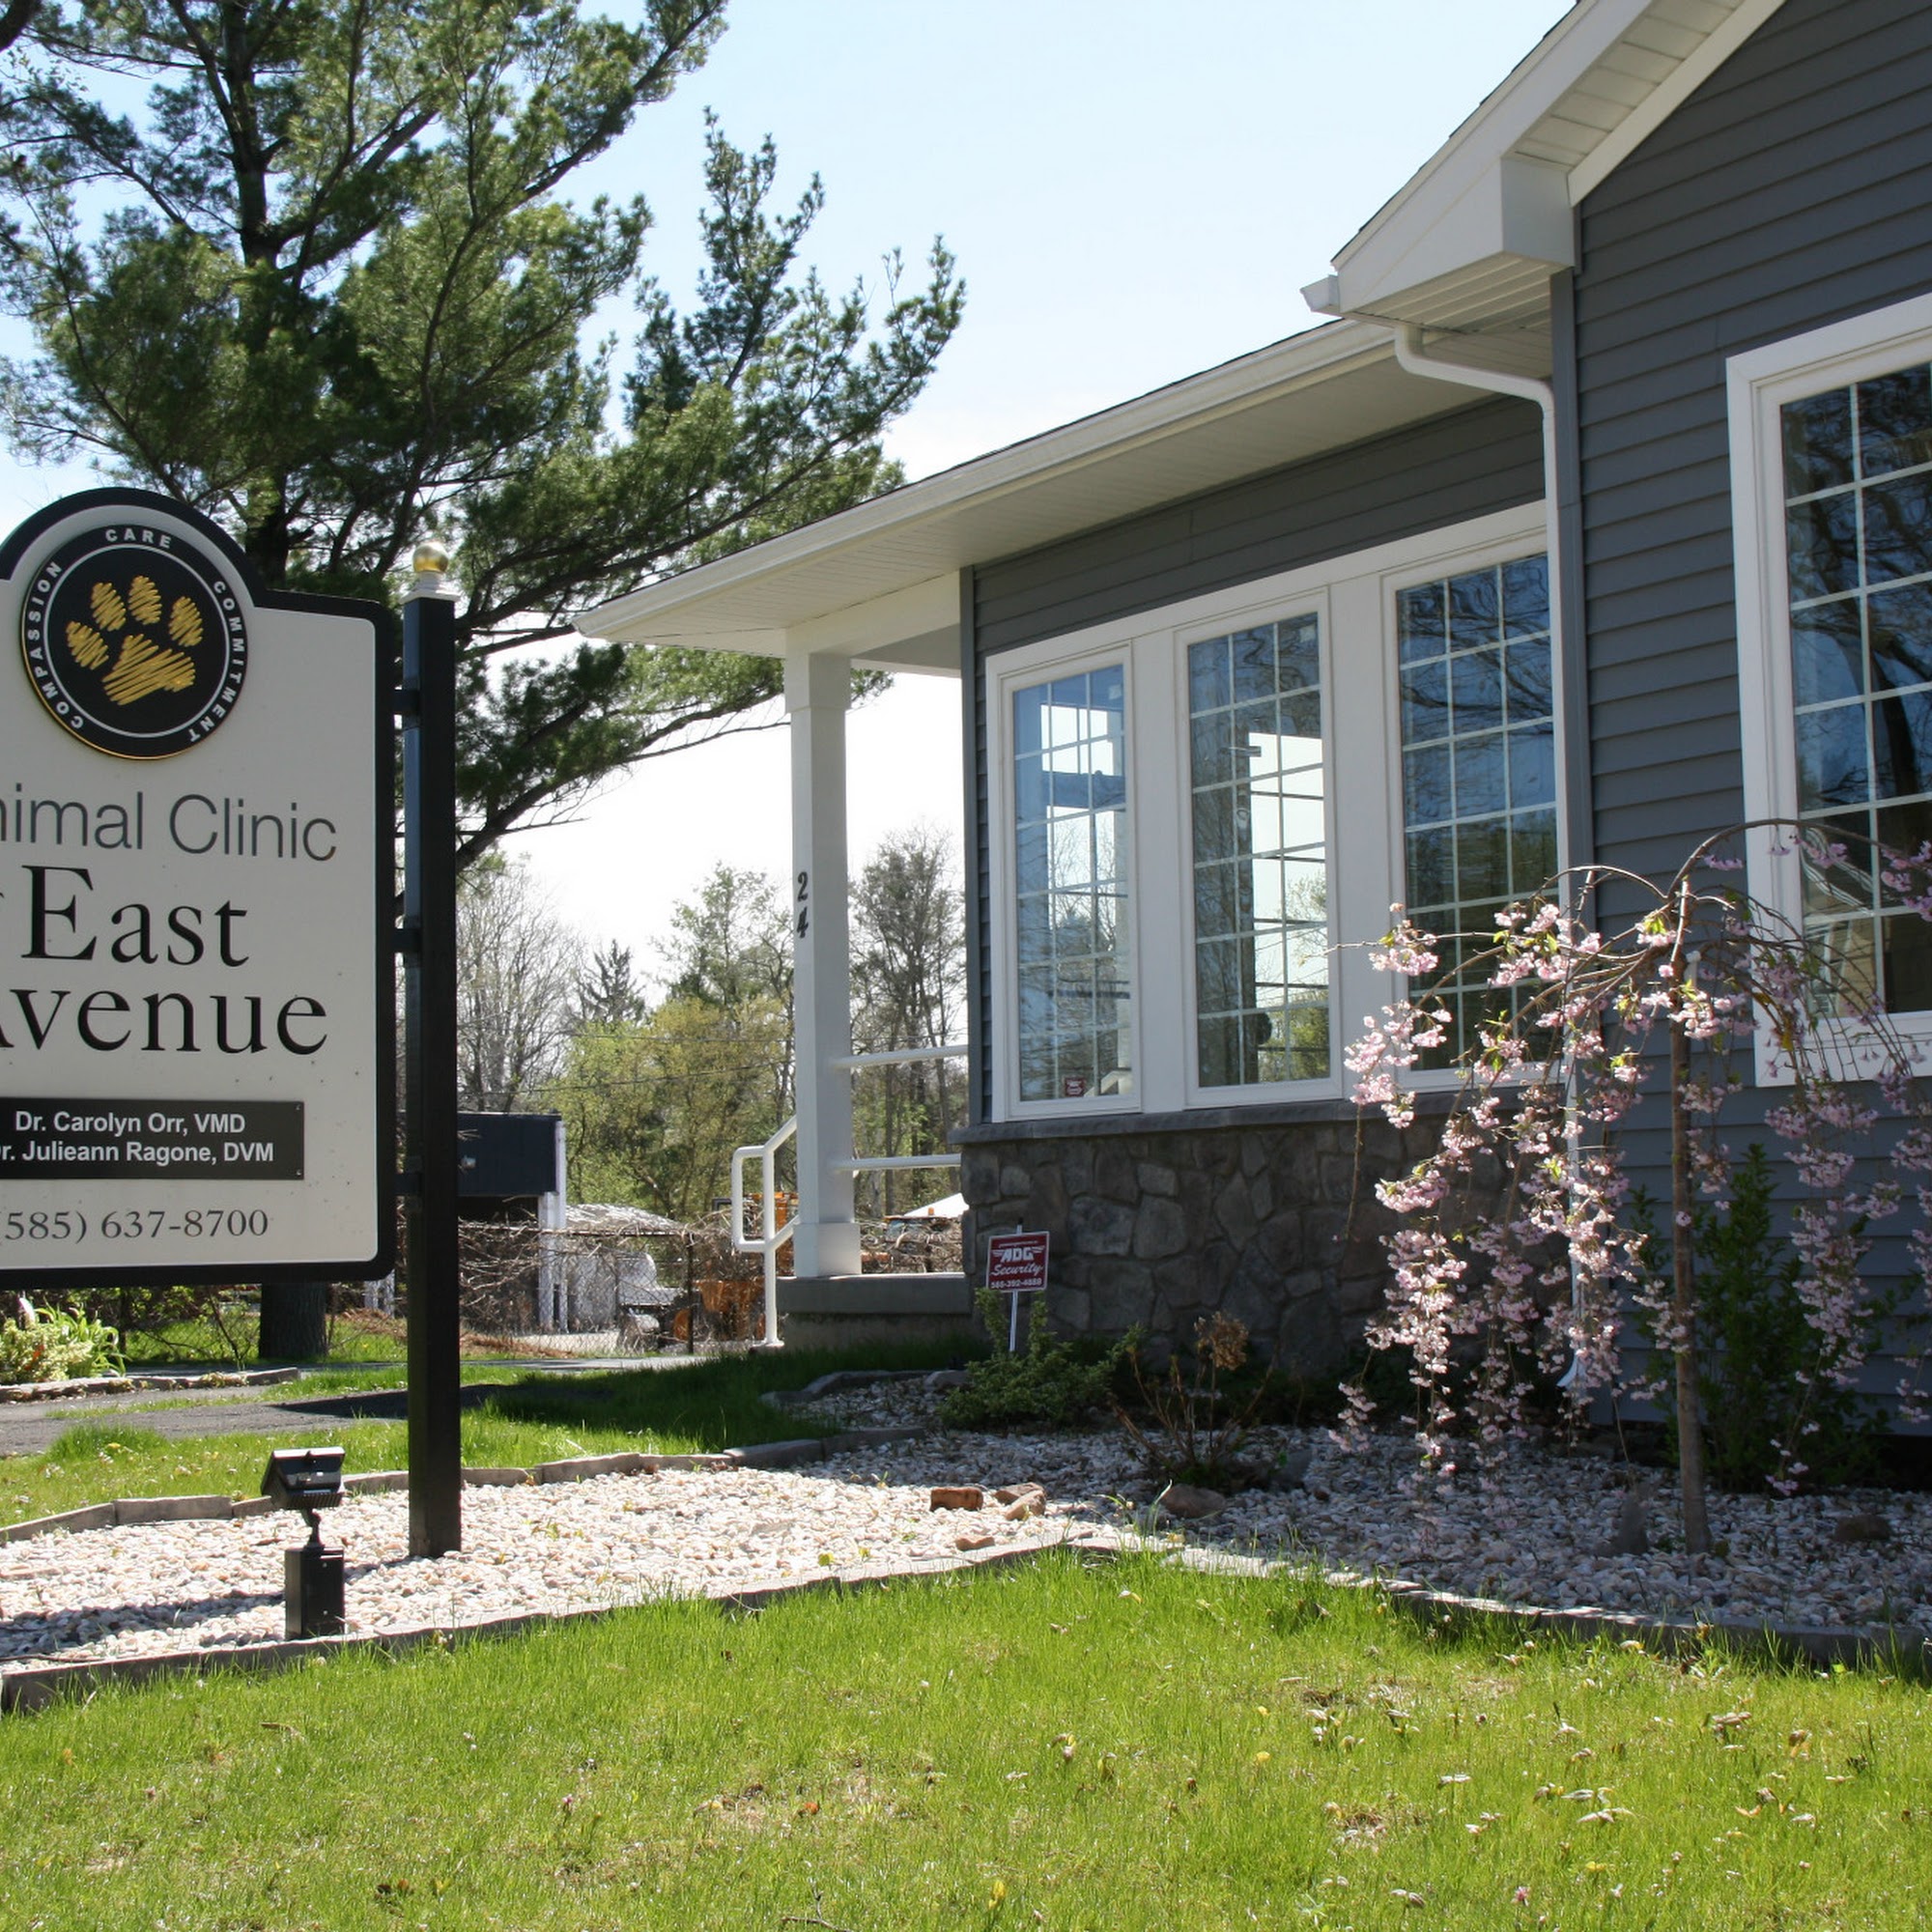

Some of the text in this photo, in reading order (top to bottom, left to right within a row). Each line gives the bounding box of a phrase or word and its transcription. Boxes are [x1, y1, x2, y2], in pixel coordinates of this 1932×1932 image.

[104, 528, 172, 550] CARE
[24, 561, 84, 729] COMPASSION
[188, 581, 245, 743] COMMITMENT
[0, 782, 337, 862] imal Clinic
[20, 865, 249, 967] East
[0, 988, 328, 1055] venue
[0, 1141, 273, 1167] r. Julieann Ragone, DVM
[15, 1111, 245, 1137] Dr. Carolyn Orr, VMD
[0, 1208, 269, 1244] 585) 637-8700
